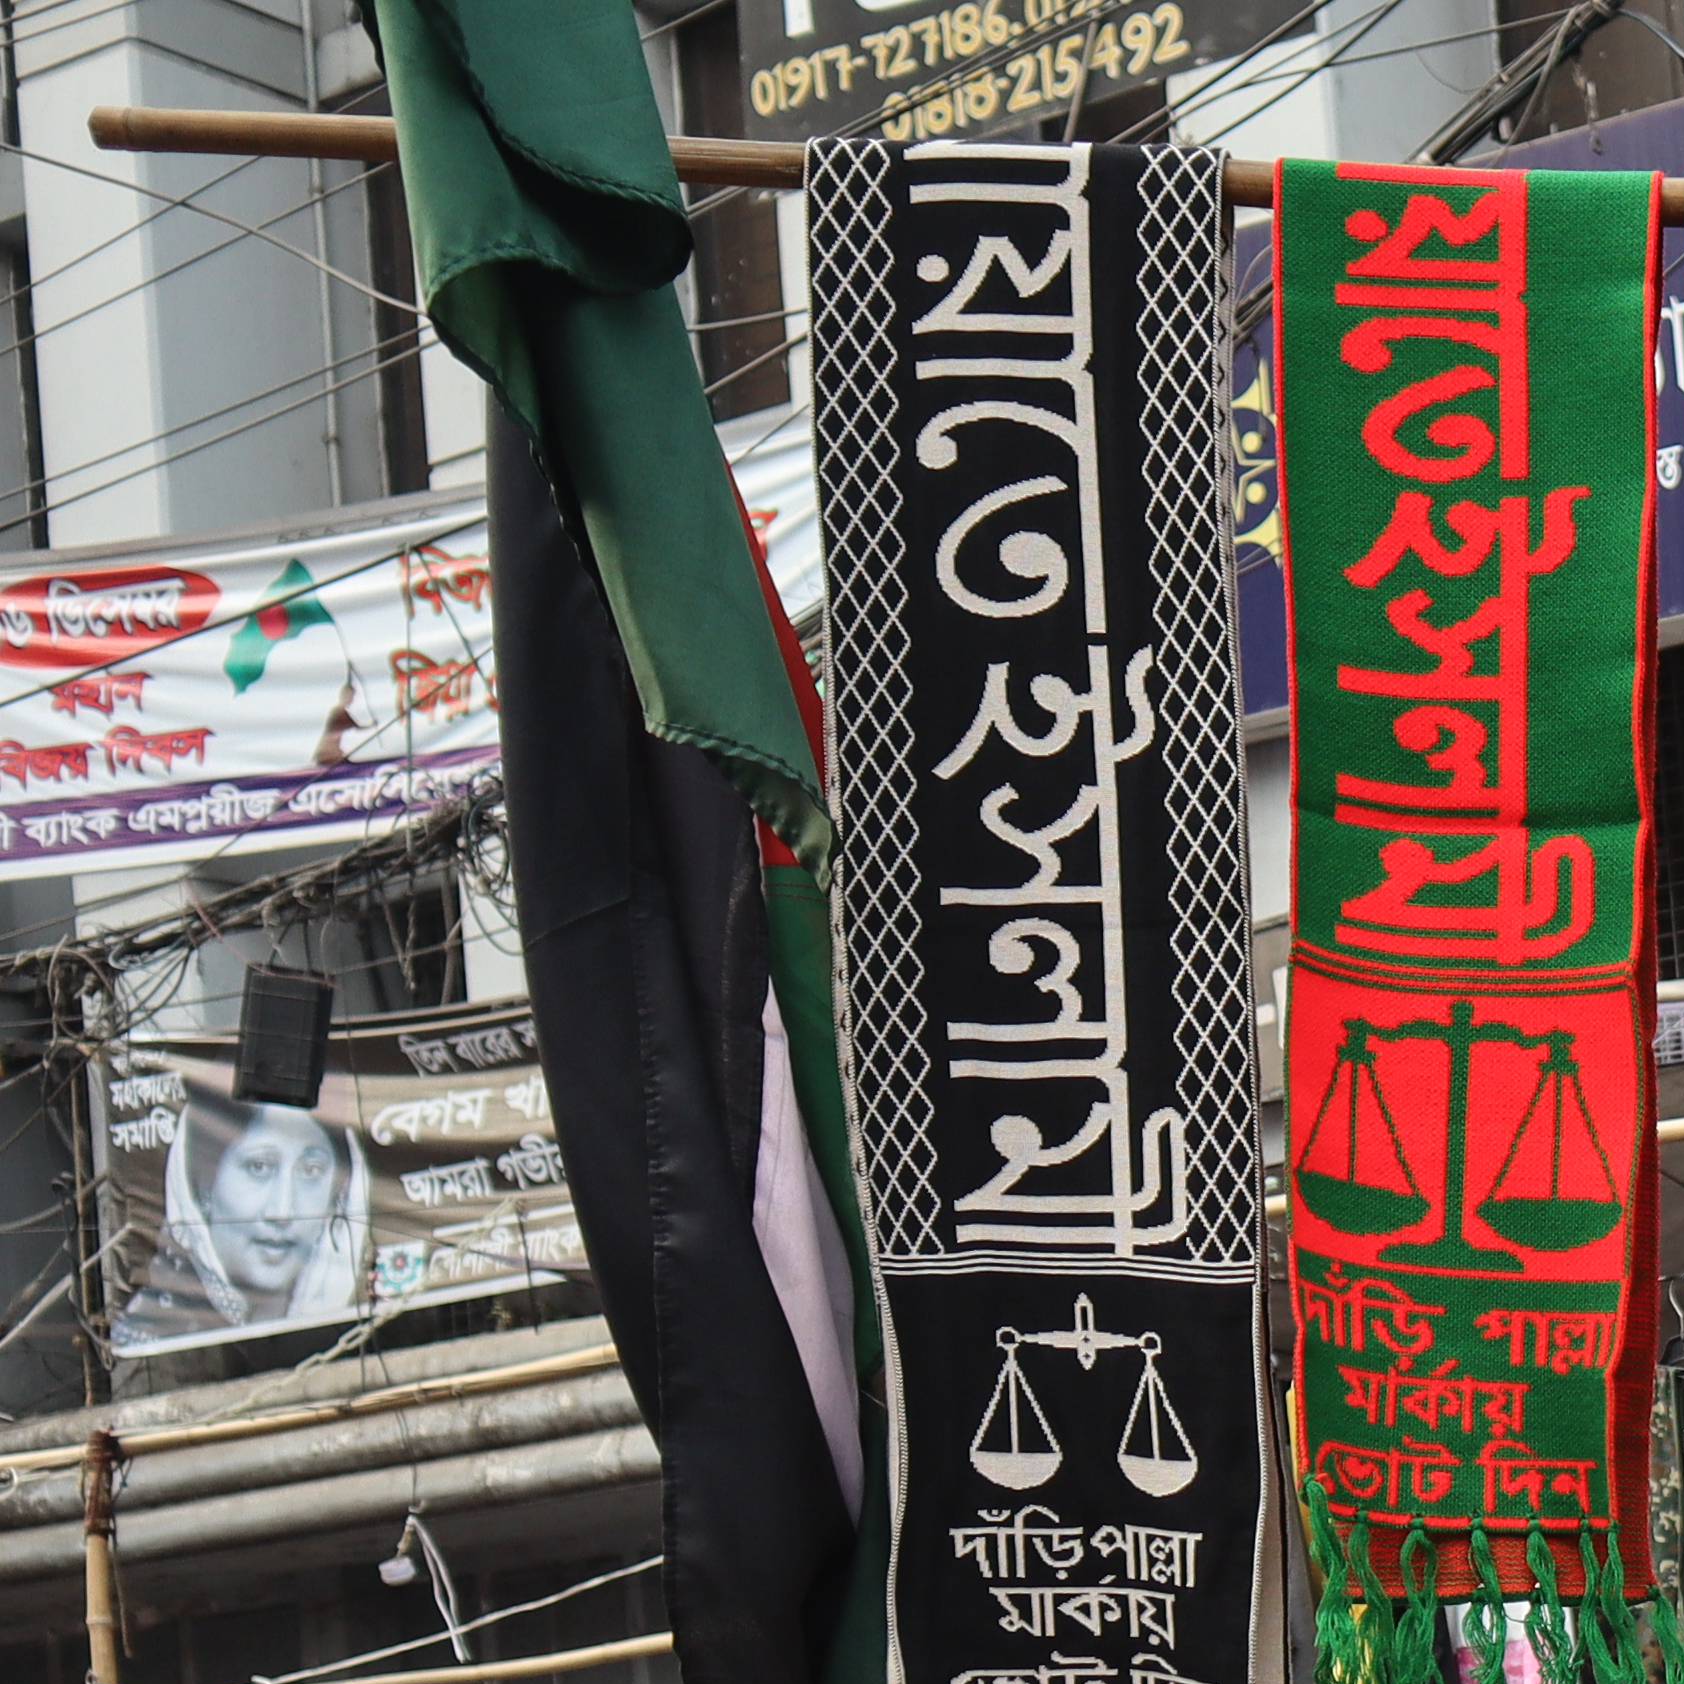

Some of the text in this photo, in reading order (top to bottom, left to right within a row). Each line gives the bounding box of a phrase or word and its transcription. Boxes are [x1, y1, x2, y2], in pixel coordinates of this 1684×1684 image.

[48, 670, 156, 723] মহান
[1336, 487, 1595, 967] ইসলামী
[99, 724, 217, 780] দিবস
[21, 806, 120, 848] ব্যাংক
[931, 644, 1189, 1256] ইসলামী
[370, 1085, 497, 1147] বেগম
[399, 1153, 493, 1209] আমরা
[1337, 1358, 1531, 1438] মার্কায়
[1315, 1434, 1598, 1513] ভোট দিন
[1089, 1524, 1203, 1588] পাল্লা
[988, 1574, 1176, 1651] মার্কায়
